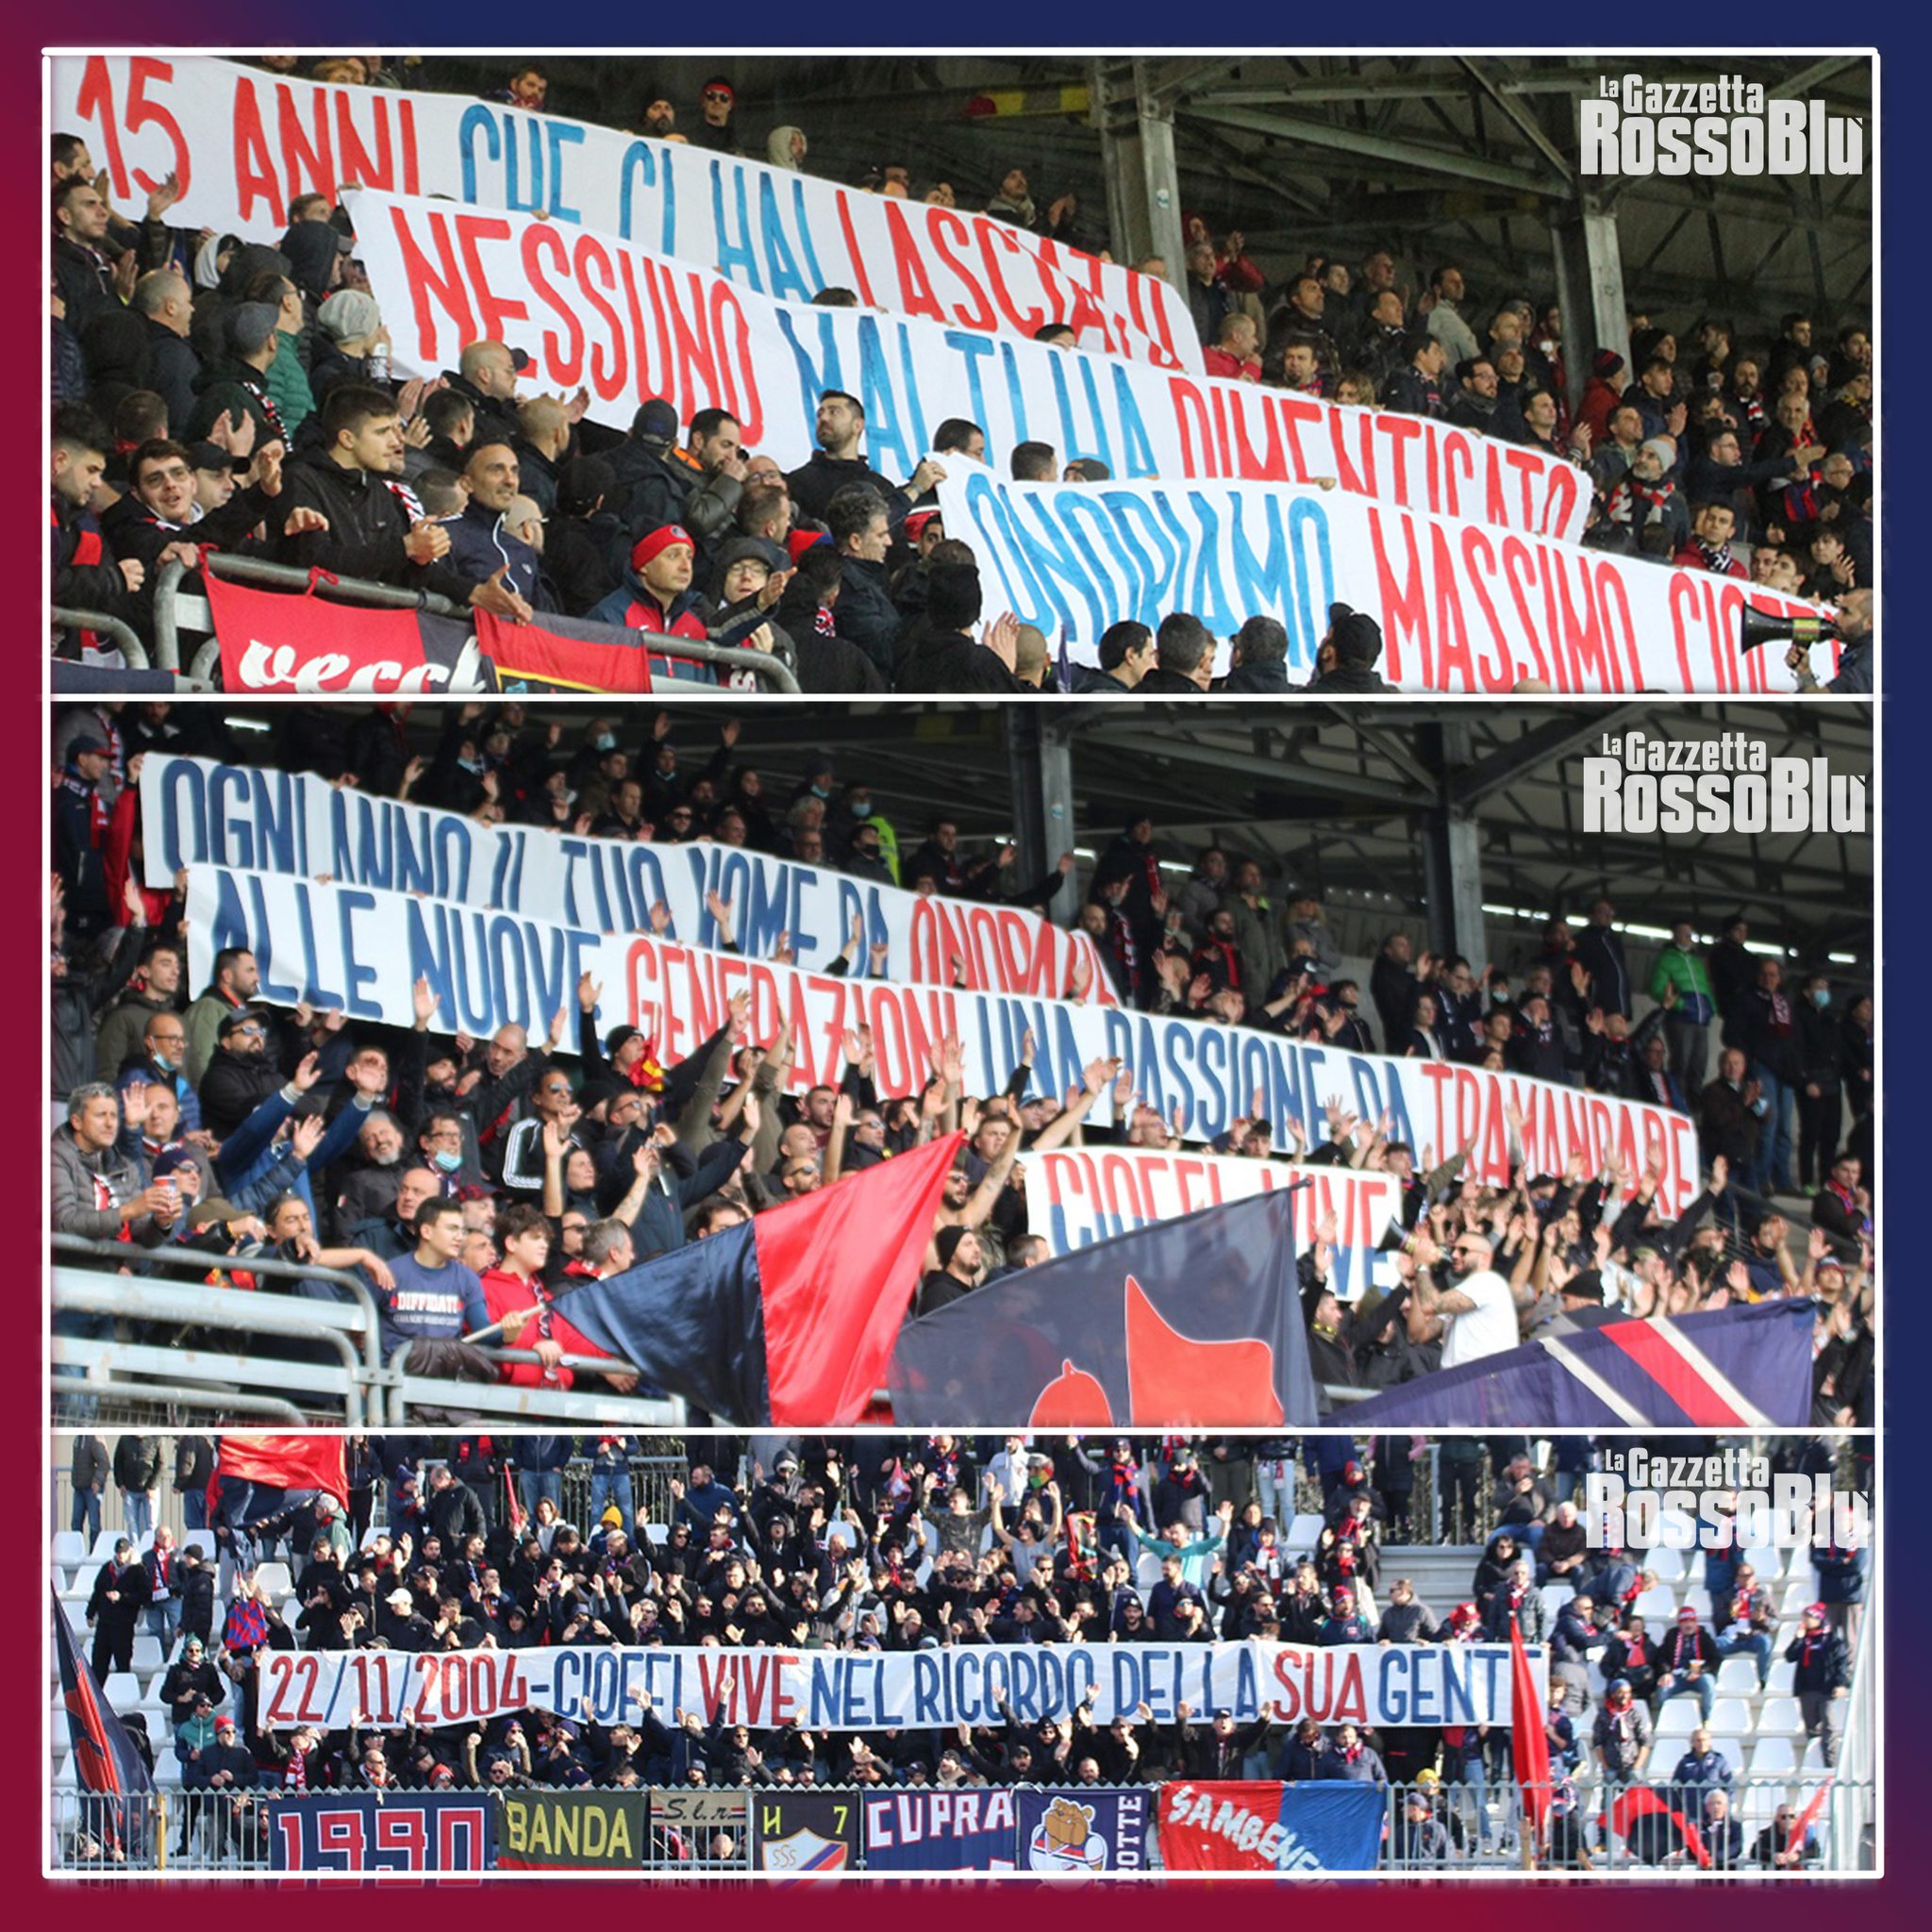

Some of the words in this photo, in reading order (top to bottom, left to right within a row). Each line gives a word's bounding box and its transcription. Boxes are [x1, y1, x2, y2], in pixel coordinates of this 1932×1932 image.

[76, 56, 190, 201] 15
[234, 76, 421, 228] ANNI
[619, 141, 675, 258] CI
[709, 158, 826, 305] HAI
[389, 206, 764, 447] NESSUNO
[774, 308, 933, 481] MAI
[1168, 376, 1578, 539] DIMENTICATO
[1367, 506, 1644, 694] MASSIMO
[1668, 571, 1841, 694] CIOFI
[161, 758, 308, 878] OGNI
[330, 789, 472, 903] ANNO
[212, 869, 384, 1020] ALLE
[406, 884, 606, 1061] NUOVE
[1104, 1009, 1326, 1150] PASSIONE
[698, 1654, 799, 1725] VIVE
[809, 1657, 904, 1725] NEL
[913, 1651, 1095, 1723] RICORDO
[1112, 1647, 1259, 1720] DELLA
[1273, 1649, 1368, 1724] SUA
[1378, 1649, 1541, 1724] GENT
[507, 1798, 634, 1859] BANDA
[833, 1806, 848, 1835] 7
[866, 1790, 1015, 1849] CUPRA
[1116, 1795, 1142, 1871] OTTE
[1168, 1784, 1328, 1871] SAMBENE
